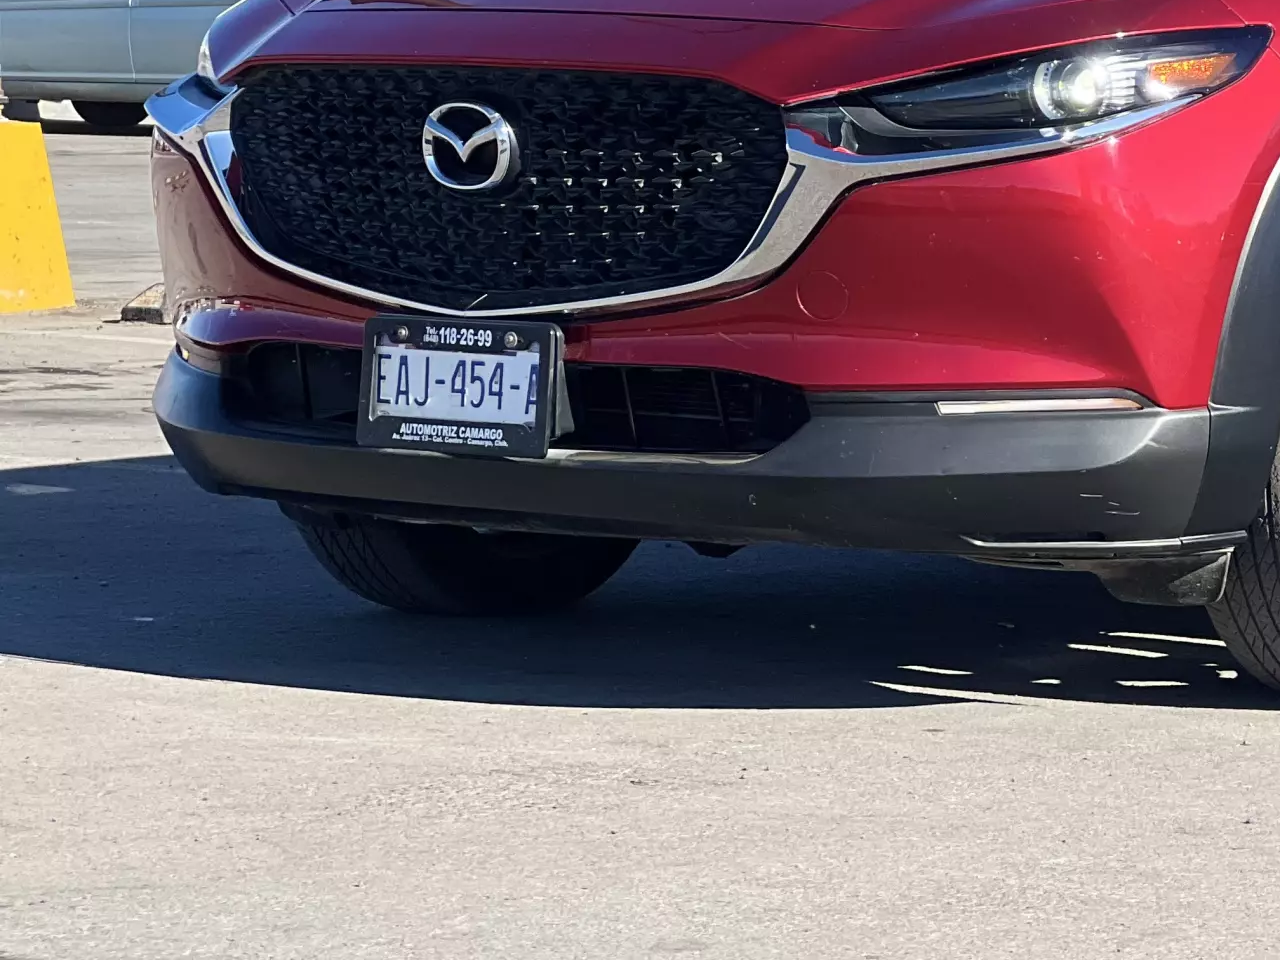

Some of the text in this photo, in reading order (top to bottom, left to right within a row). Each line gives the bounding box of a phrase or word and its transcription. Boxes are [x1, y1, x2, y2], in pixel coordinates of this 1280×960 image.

[439, 326, 493, 347] 118-26-99
[399, 422, 503, 440] AUTOMOTRIZ CAMARGO
